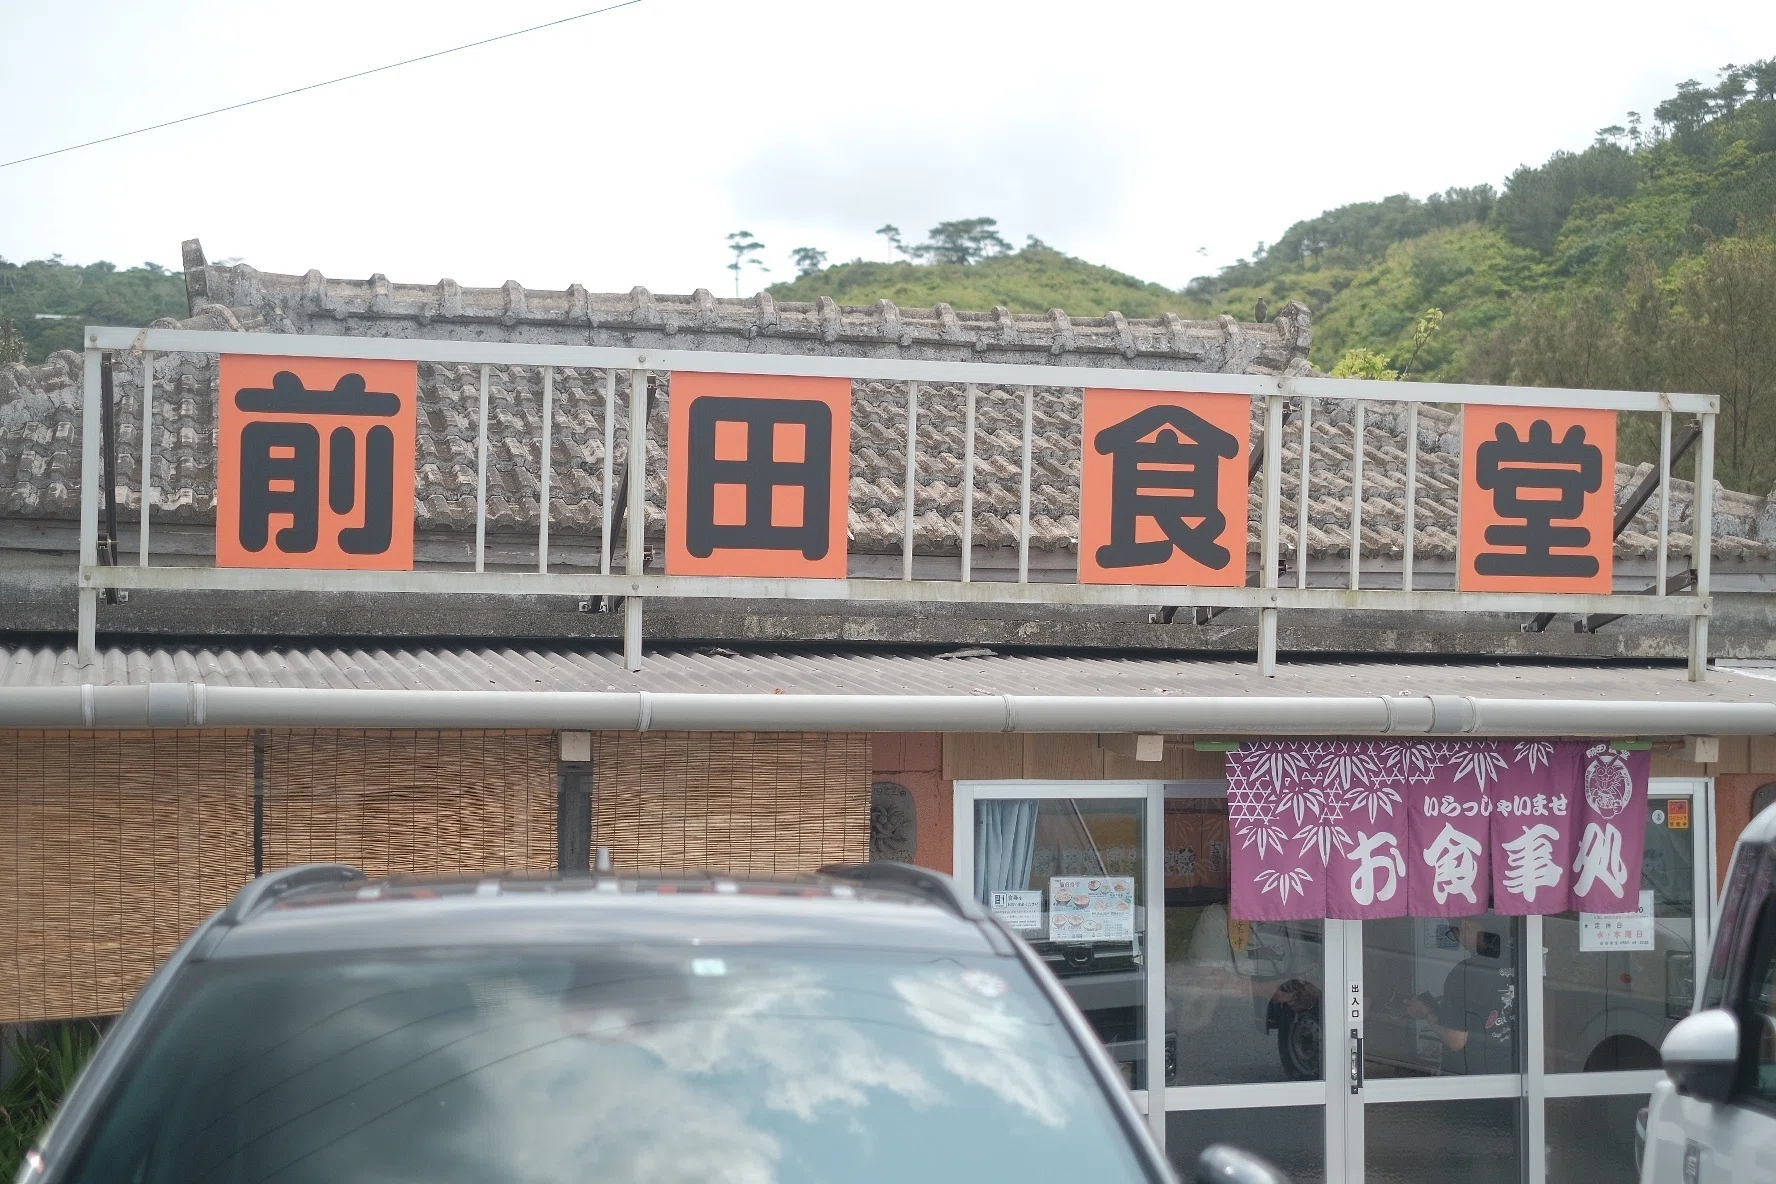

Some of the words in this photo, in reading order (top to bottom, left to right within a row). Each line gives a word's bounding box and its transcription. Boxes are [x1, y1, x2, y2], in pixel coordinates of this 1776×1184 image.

[1424, 794, 1568, 816] いらっしゃいませ
[1348, 822, 1628, 904] お食事処
[1351, 984, 1360, 1018] 出入口
